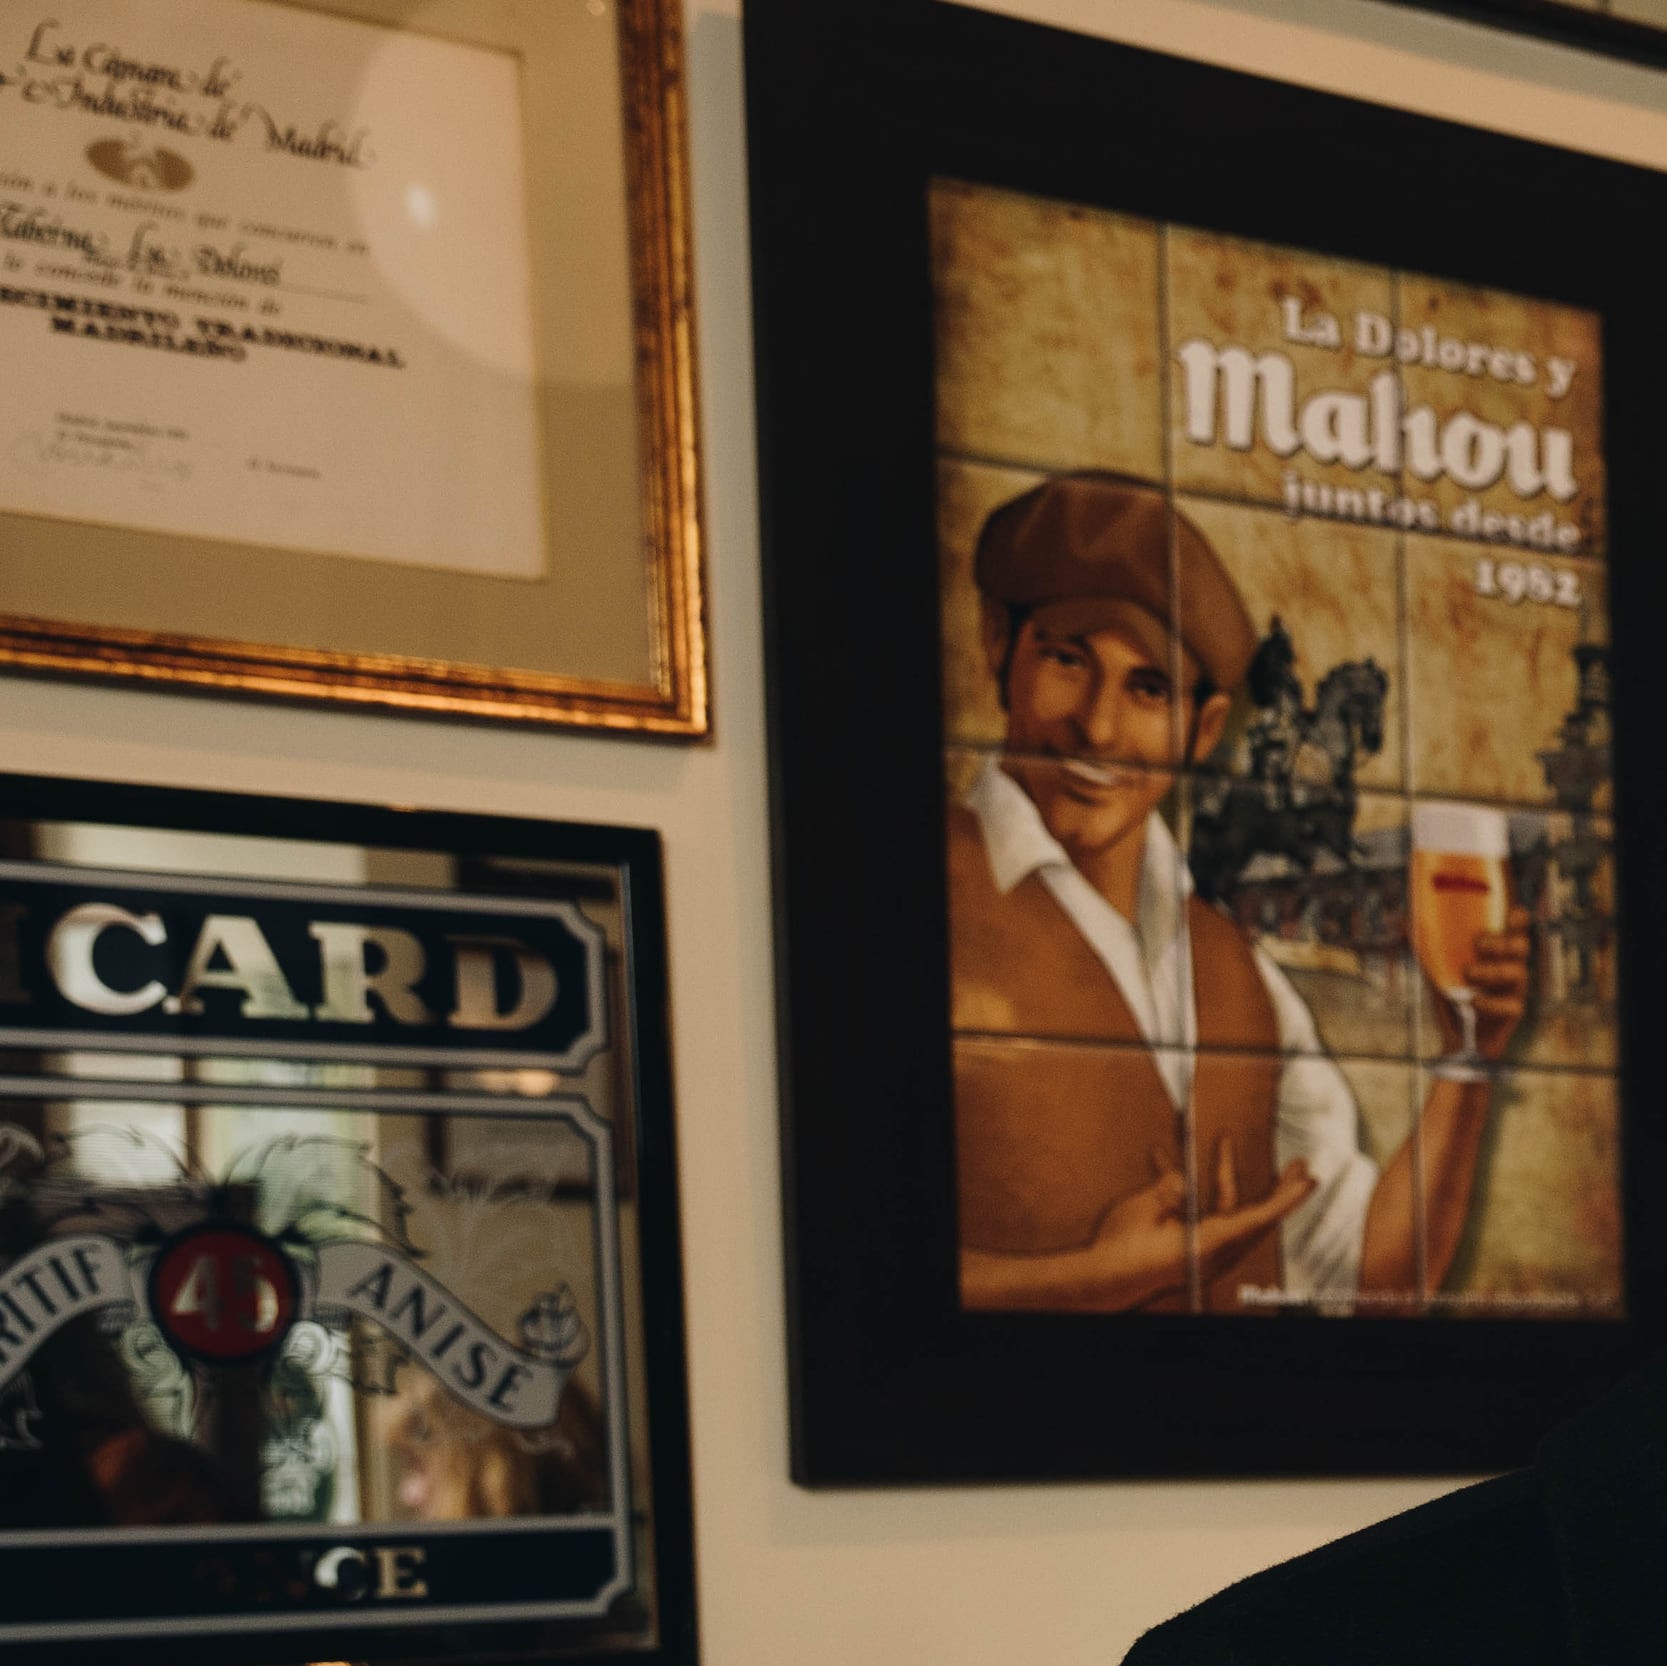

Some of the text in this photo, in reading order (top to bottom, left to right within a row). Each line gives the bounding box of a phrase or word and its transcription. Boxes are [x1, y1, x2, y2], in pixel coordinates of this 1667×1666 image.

[1283, 296, 1578, 397] La Dolores y
[1178, 338, 1579, 501] Mahou
[1282, 468, 1581, 553] juntos desde
[173, 1254, 279, 1334] 45
